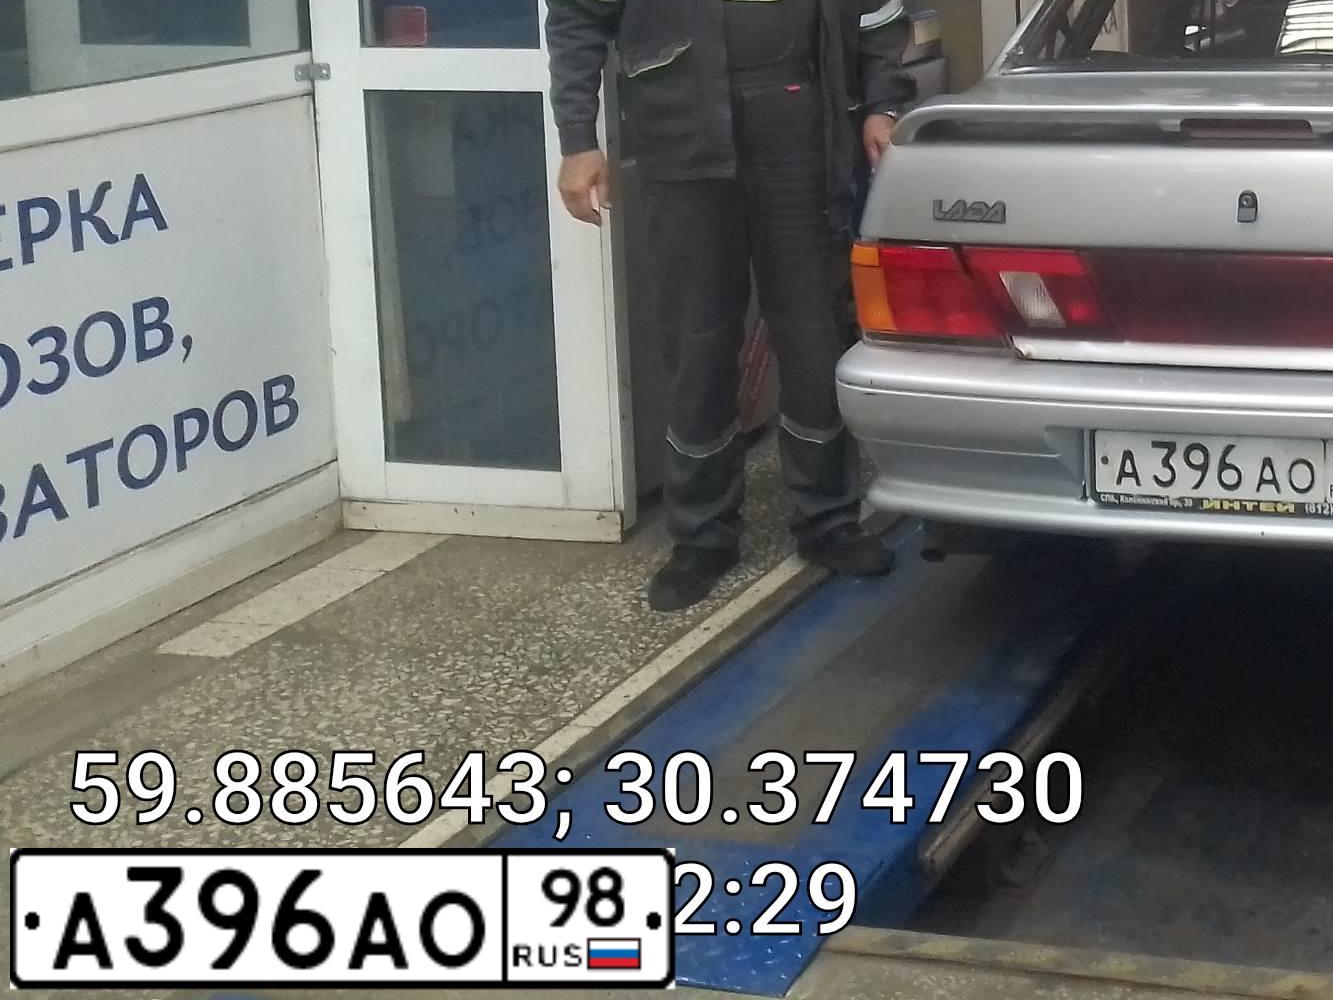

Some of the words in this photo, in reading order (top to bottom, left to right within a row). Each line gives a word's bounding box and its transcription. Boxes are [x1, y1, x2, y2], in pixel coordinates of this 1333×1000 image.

[933, 199, 1006, 224] LADA
[0, 373, 300, 543] АТОРОВ
[1115, 440, 1315, 494] А396АО
